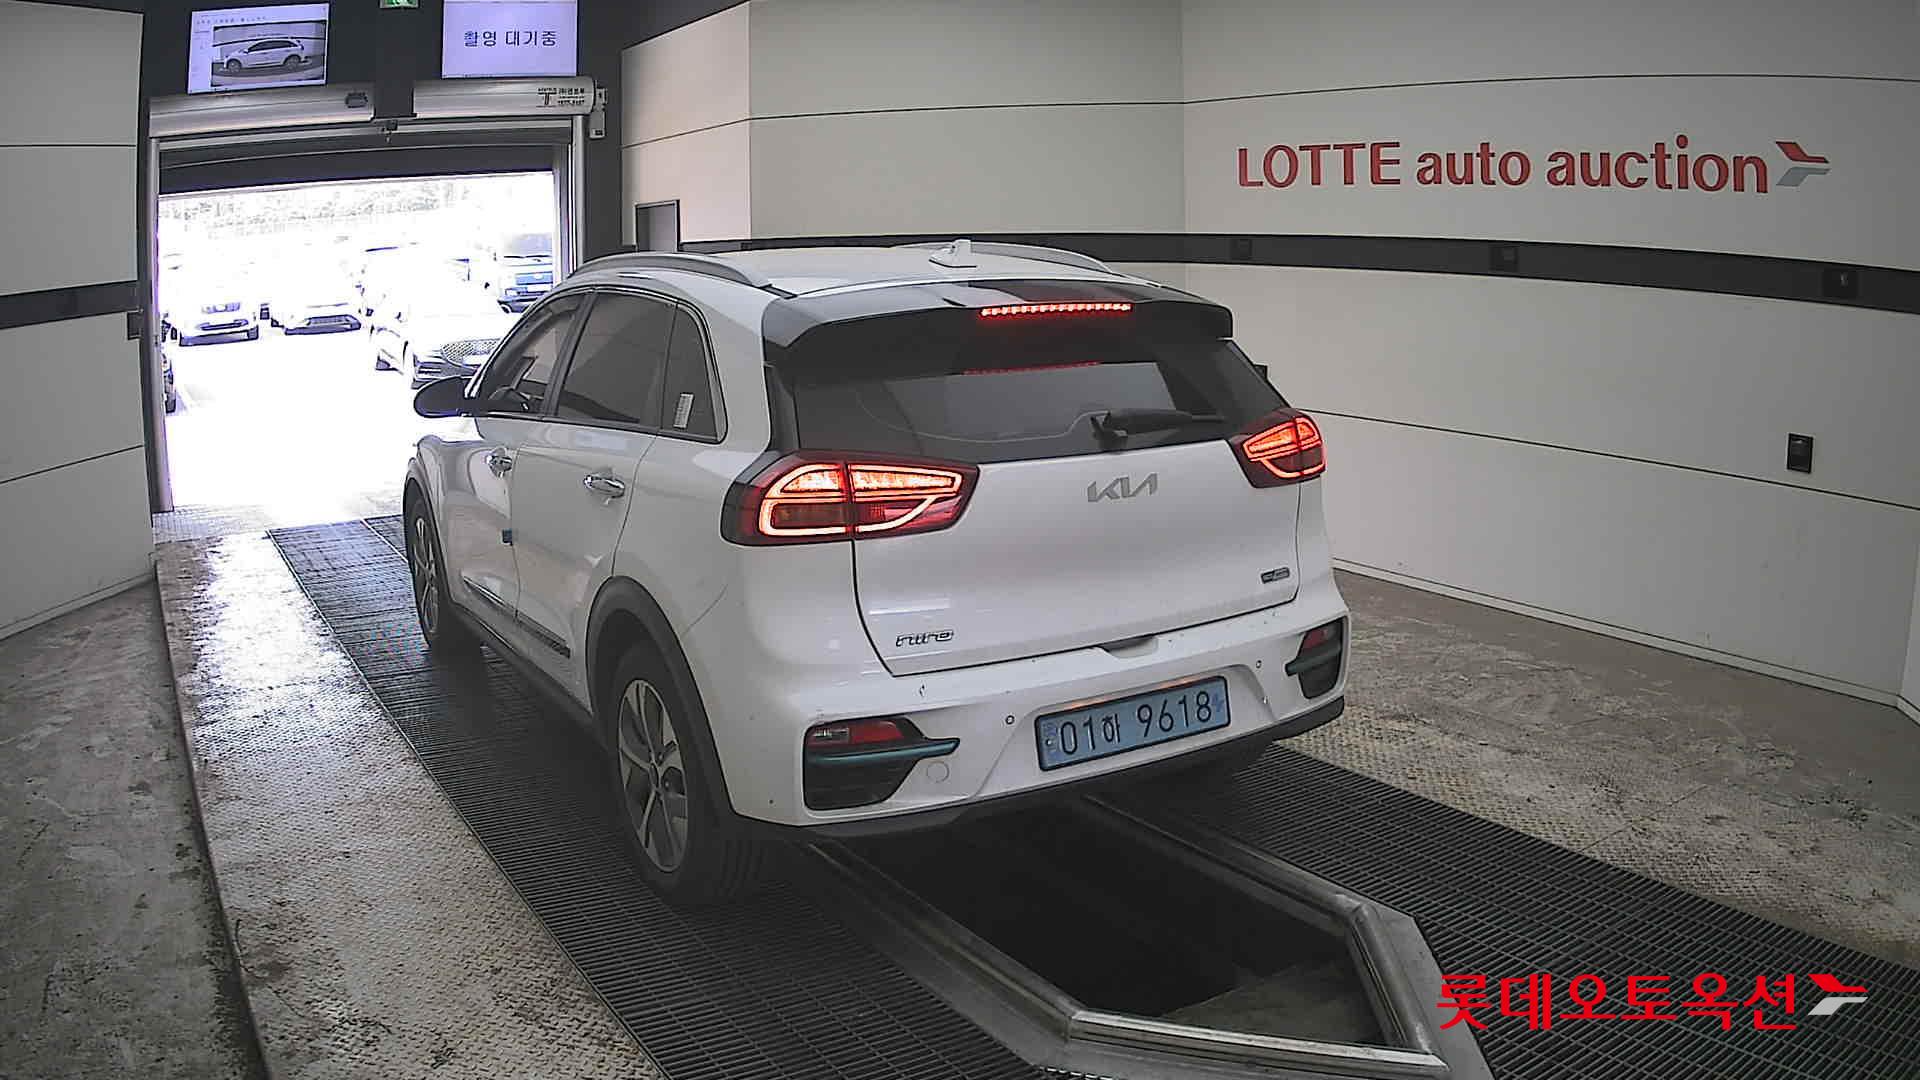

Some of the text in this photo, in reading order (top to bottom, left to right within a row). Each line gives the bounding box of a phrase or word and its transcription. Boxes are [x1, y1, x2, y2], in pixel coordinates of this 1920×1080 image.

[505, 30, 556, 47] 대기중
[1236, 134, 1769, 194] LOTTE auto auction
[1087, 472, 1158, 502] KIA
[1060, 691, 1212, 755] 01하 9618
